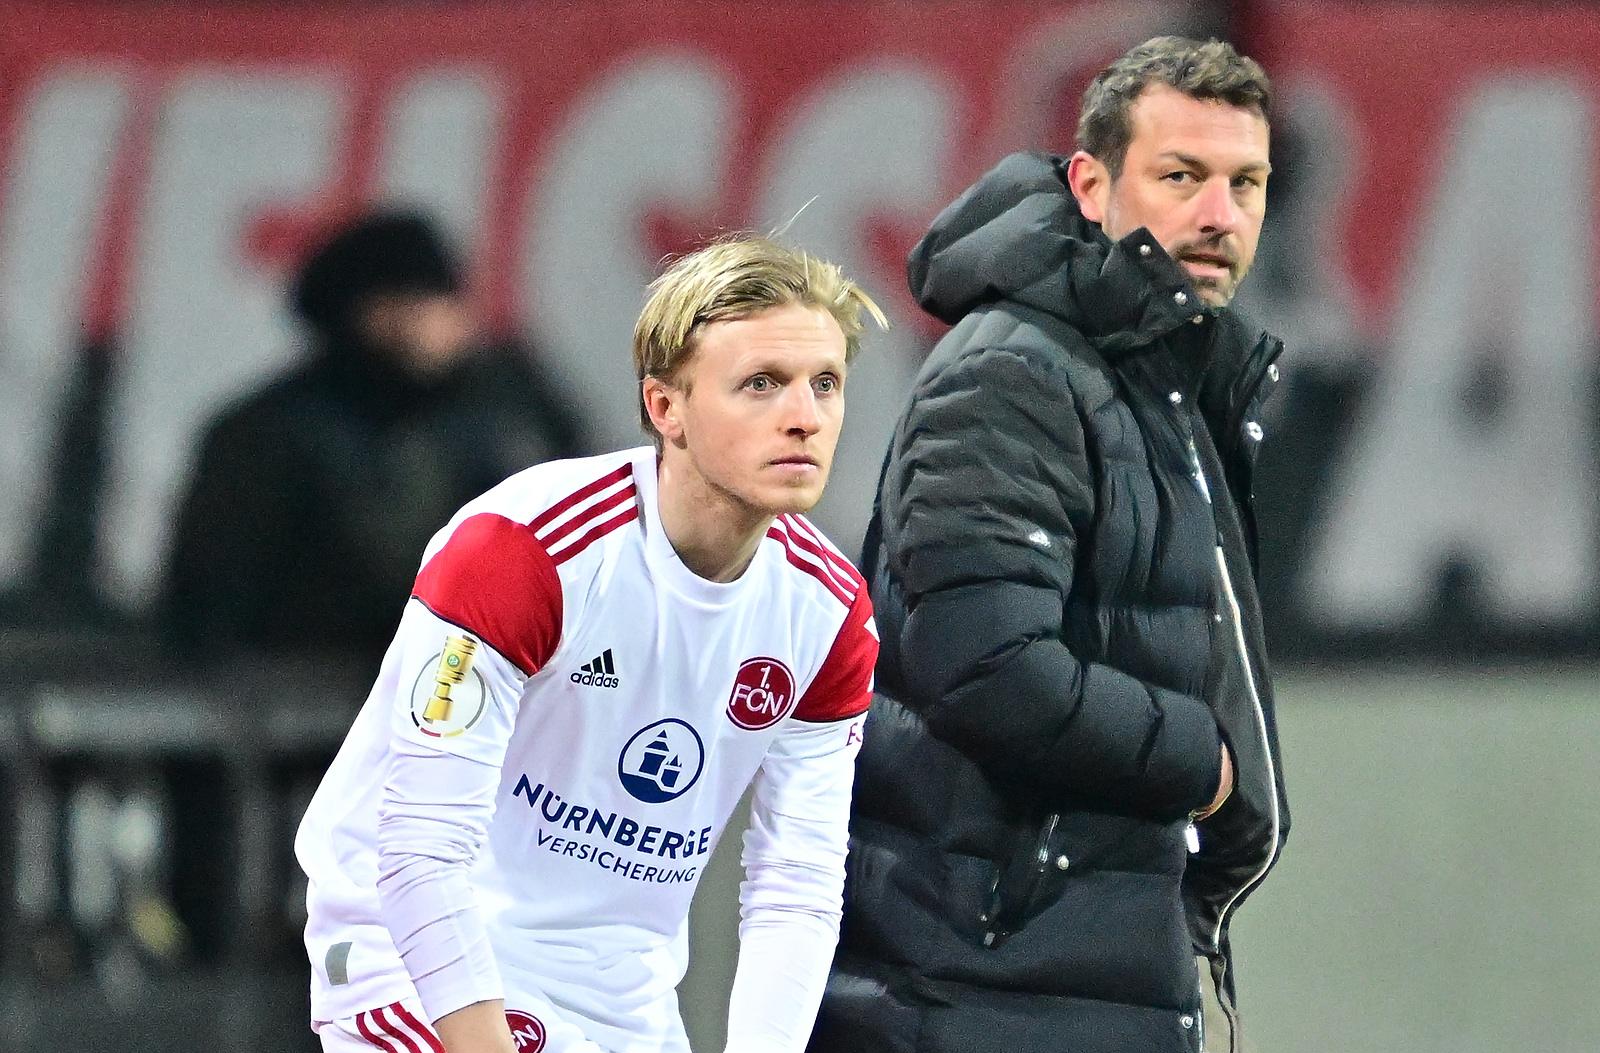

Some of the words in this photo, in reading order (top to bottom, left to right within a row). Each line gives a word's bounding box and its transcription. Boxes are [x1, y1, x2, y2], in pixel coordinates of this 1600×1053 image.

[570, 670, 620, 689] adidas
[730, 683, 785, 717] FCN
[537, 828, 697, 885] VERSICHERUNG
